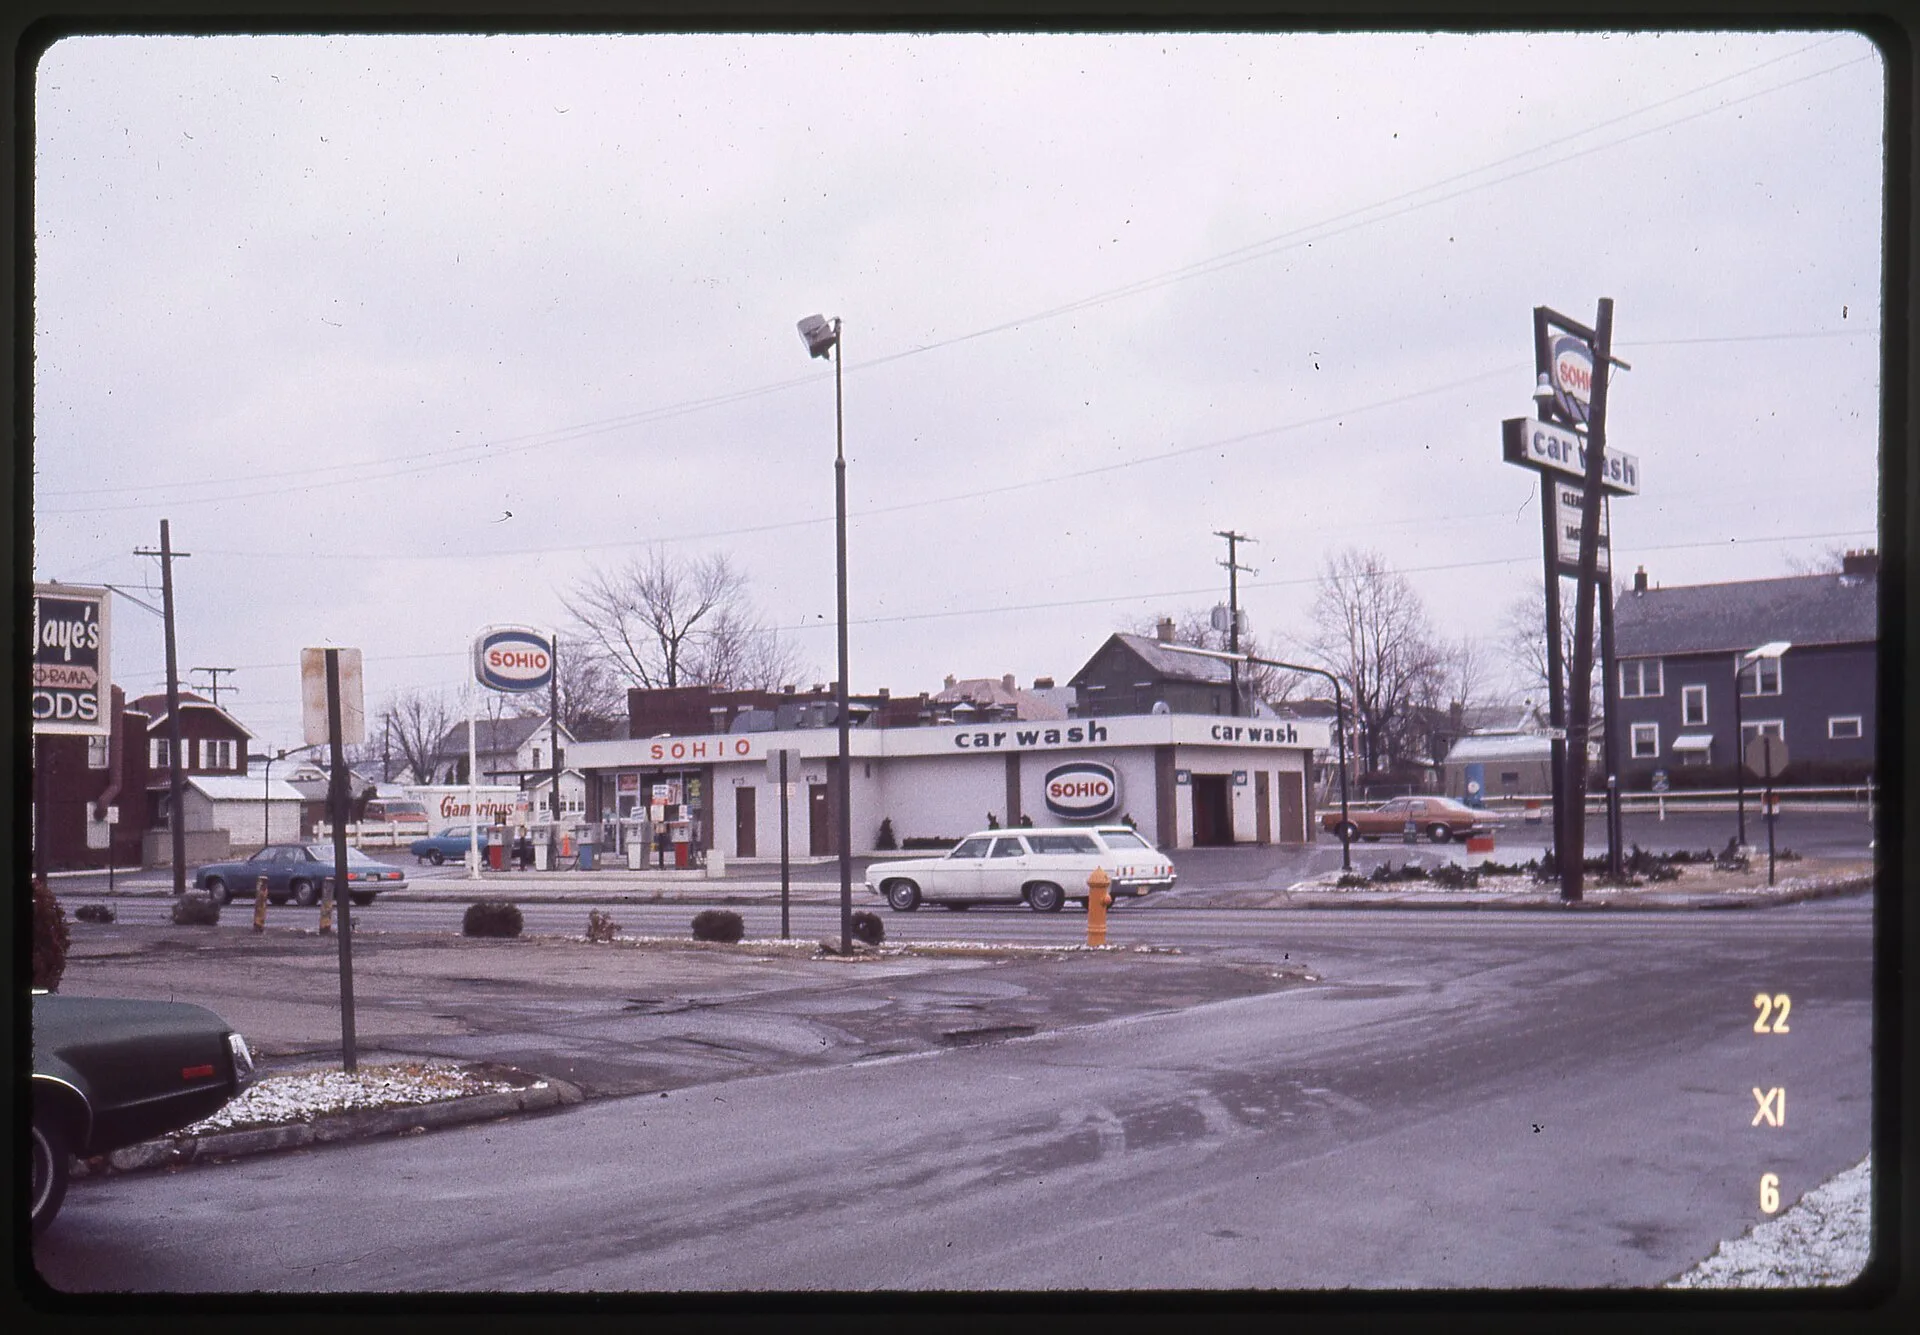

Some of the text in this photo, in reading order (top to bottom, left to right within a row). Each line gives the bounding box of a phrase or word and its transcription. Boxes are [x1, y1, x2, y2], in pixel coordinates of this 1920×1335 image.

[1560, 361, 1593, 391] SOHI
[1533, 430, 1572, 463] car
[490, 651, 547, 669] SOHIO
[955, 721, 1107, 748] car wash
[1211, 723, 1298, 743] car wash
[650, 739, 750, 760] SOHIO
[1050, 781, 1109, 798] SOHIO
[440, 795, 514, 818] Gamrinus
